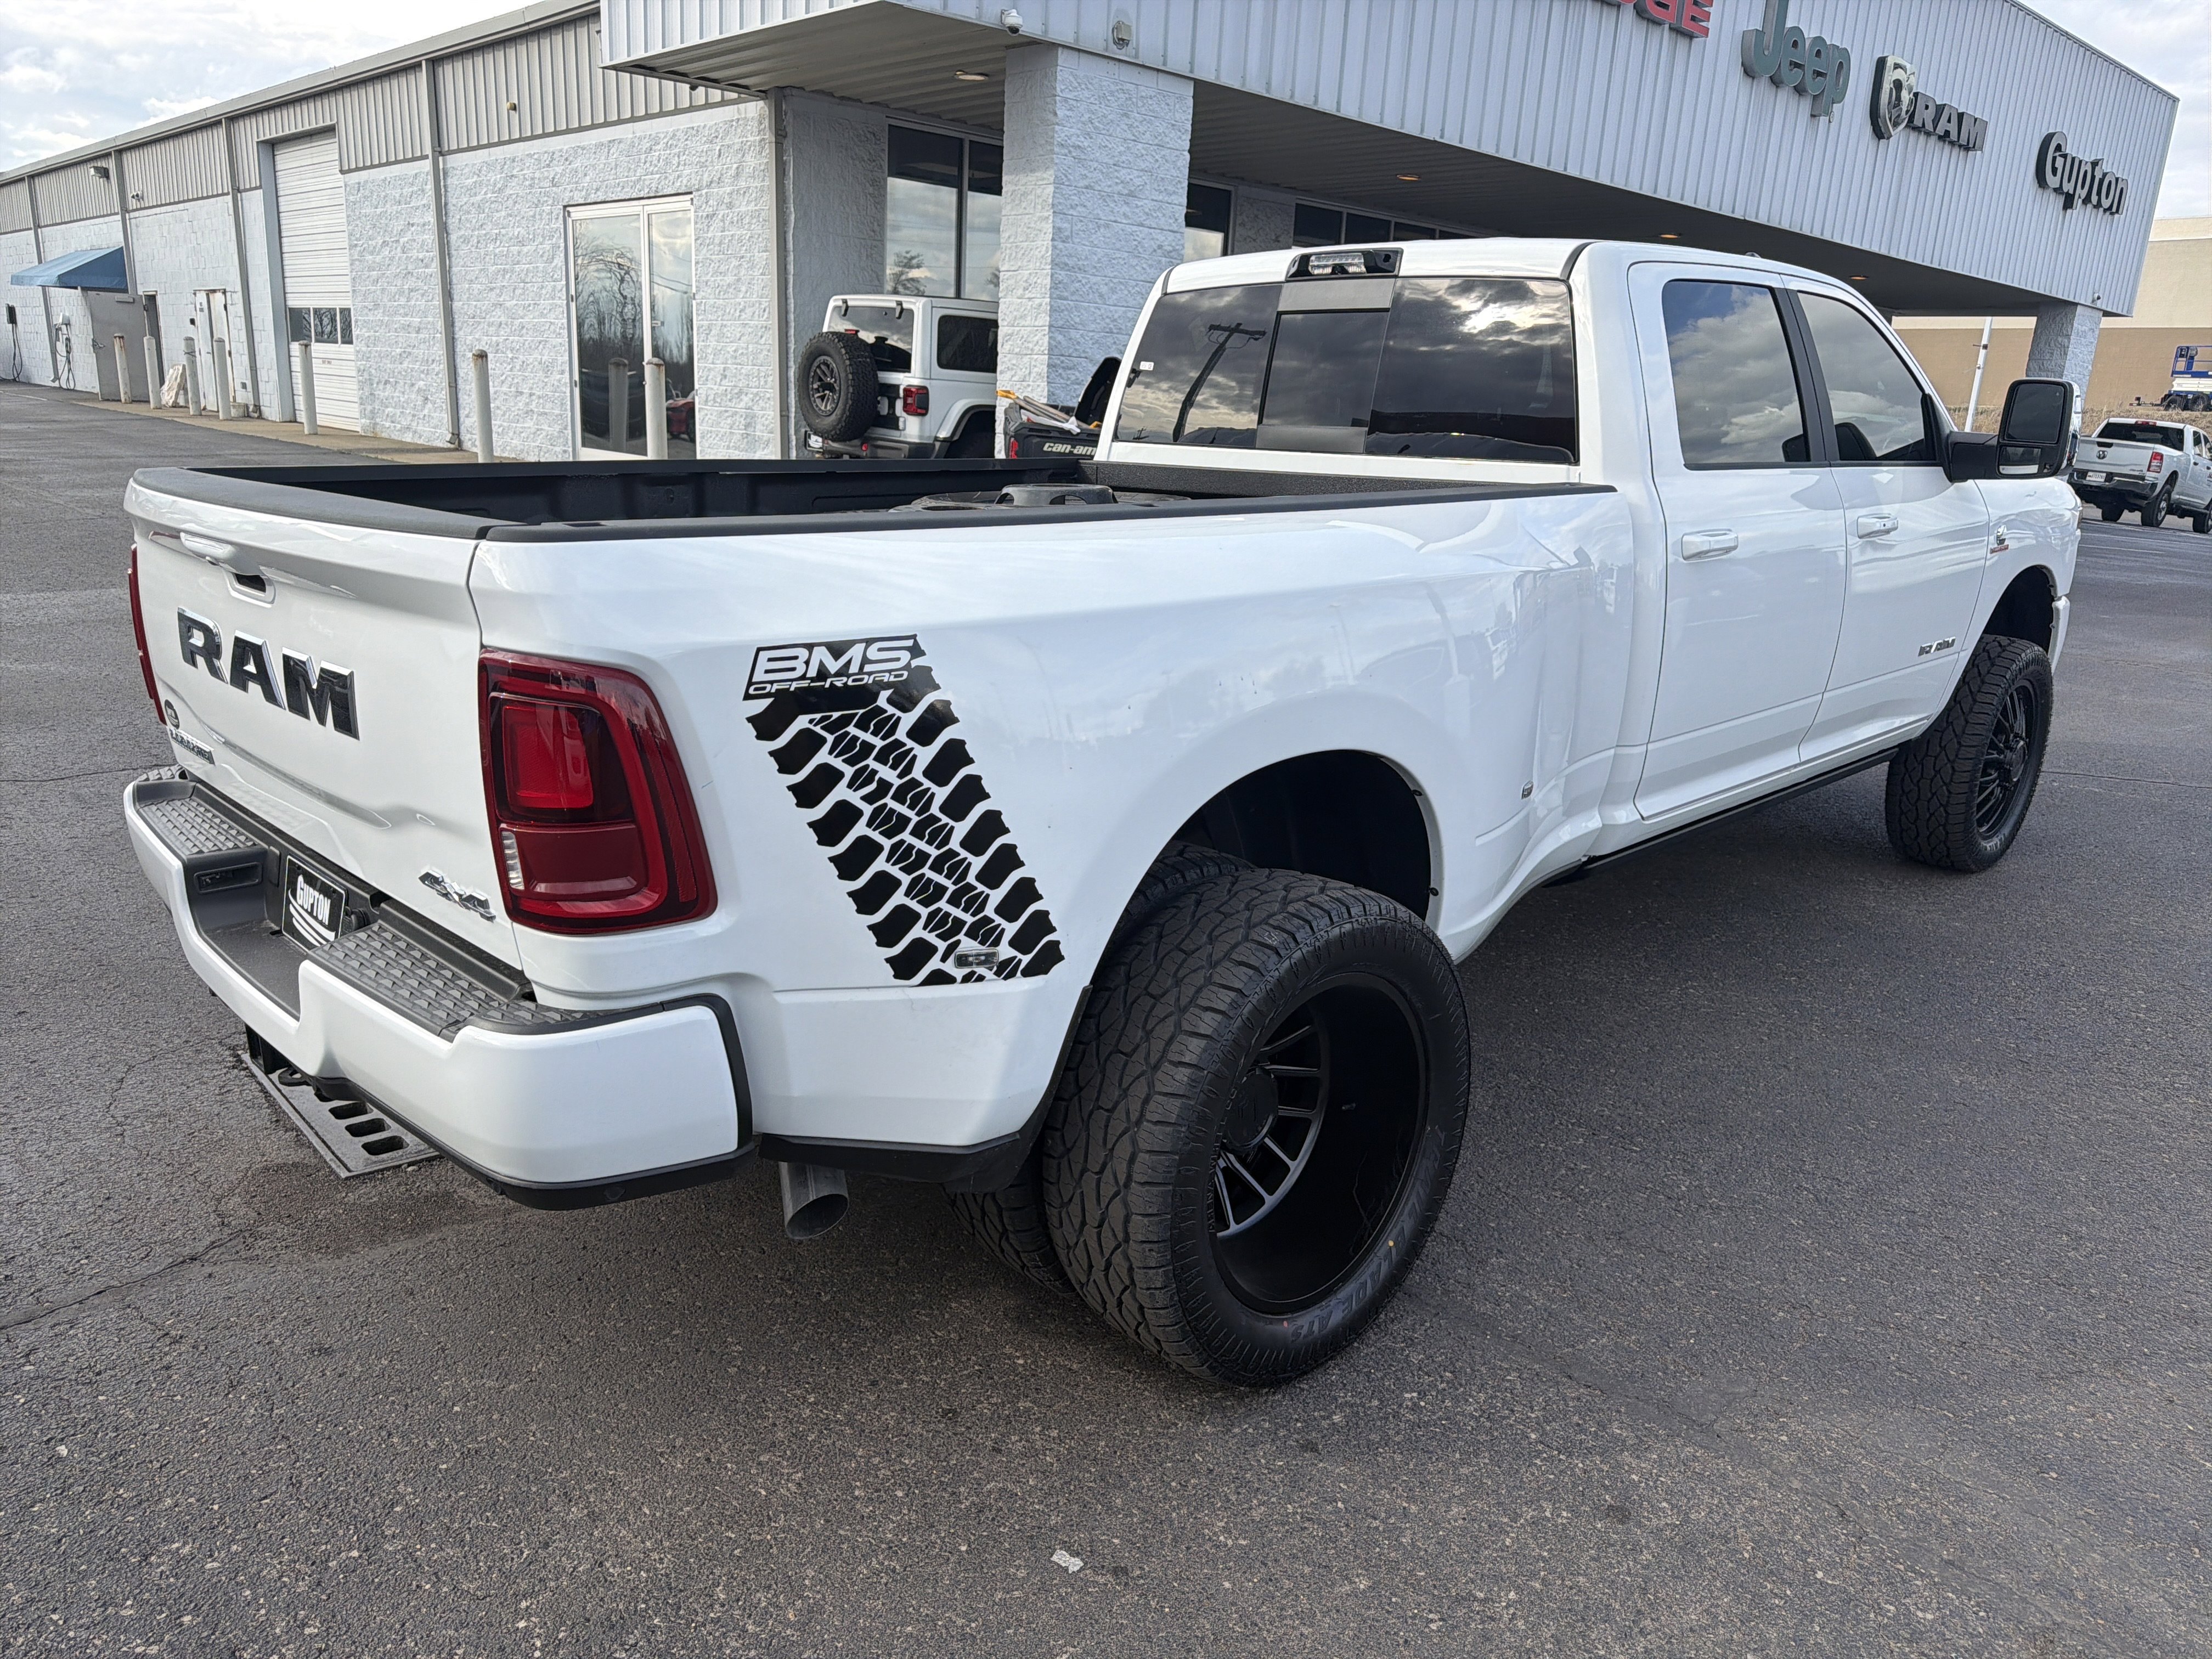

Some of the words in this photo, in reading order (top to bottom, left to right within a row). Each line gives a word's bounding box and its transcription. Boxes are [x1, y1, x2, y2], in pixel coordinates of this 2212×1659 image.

[1741, 0, 1850, 117] Jeep
[1908, 91, 1988, 151] RAM
[2036, 131, 2128, 215] Gupton
[1043, 442, 1097, 455] can-am
[752, 639, 915, 682] BMS
[1918, 636, 1956, 657] RAM
[177, 607, 359, 740] RAM
[748, 670, 909, 695] OFF-ROAD
[296, 874, 331, 926] GUPTON
